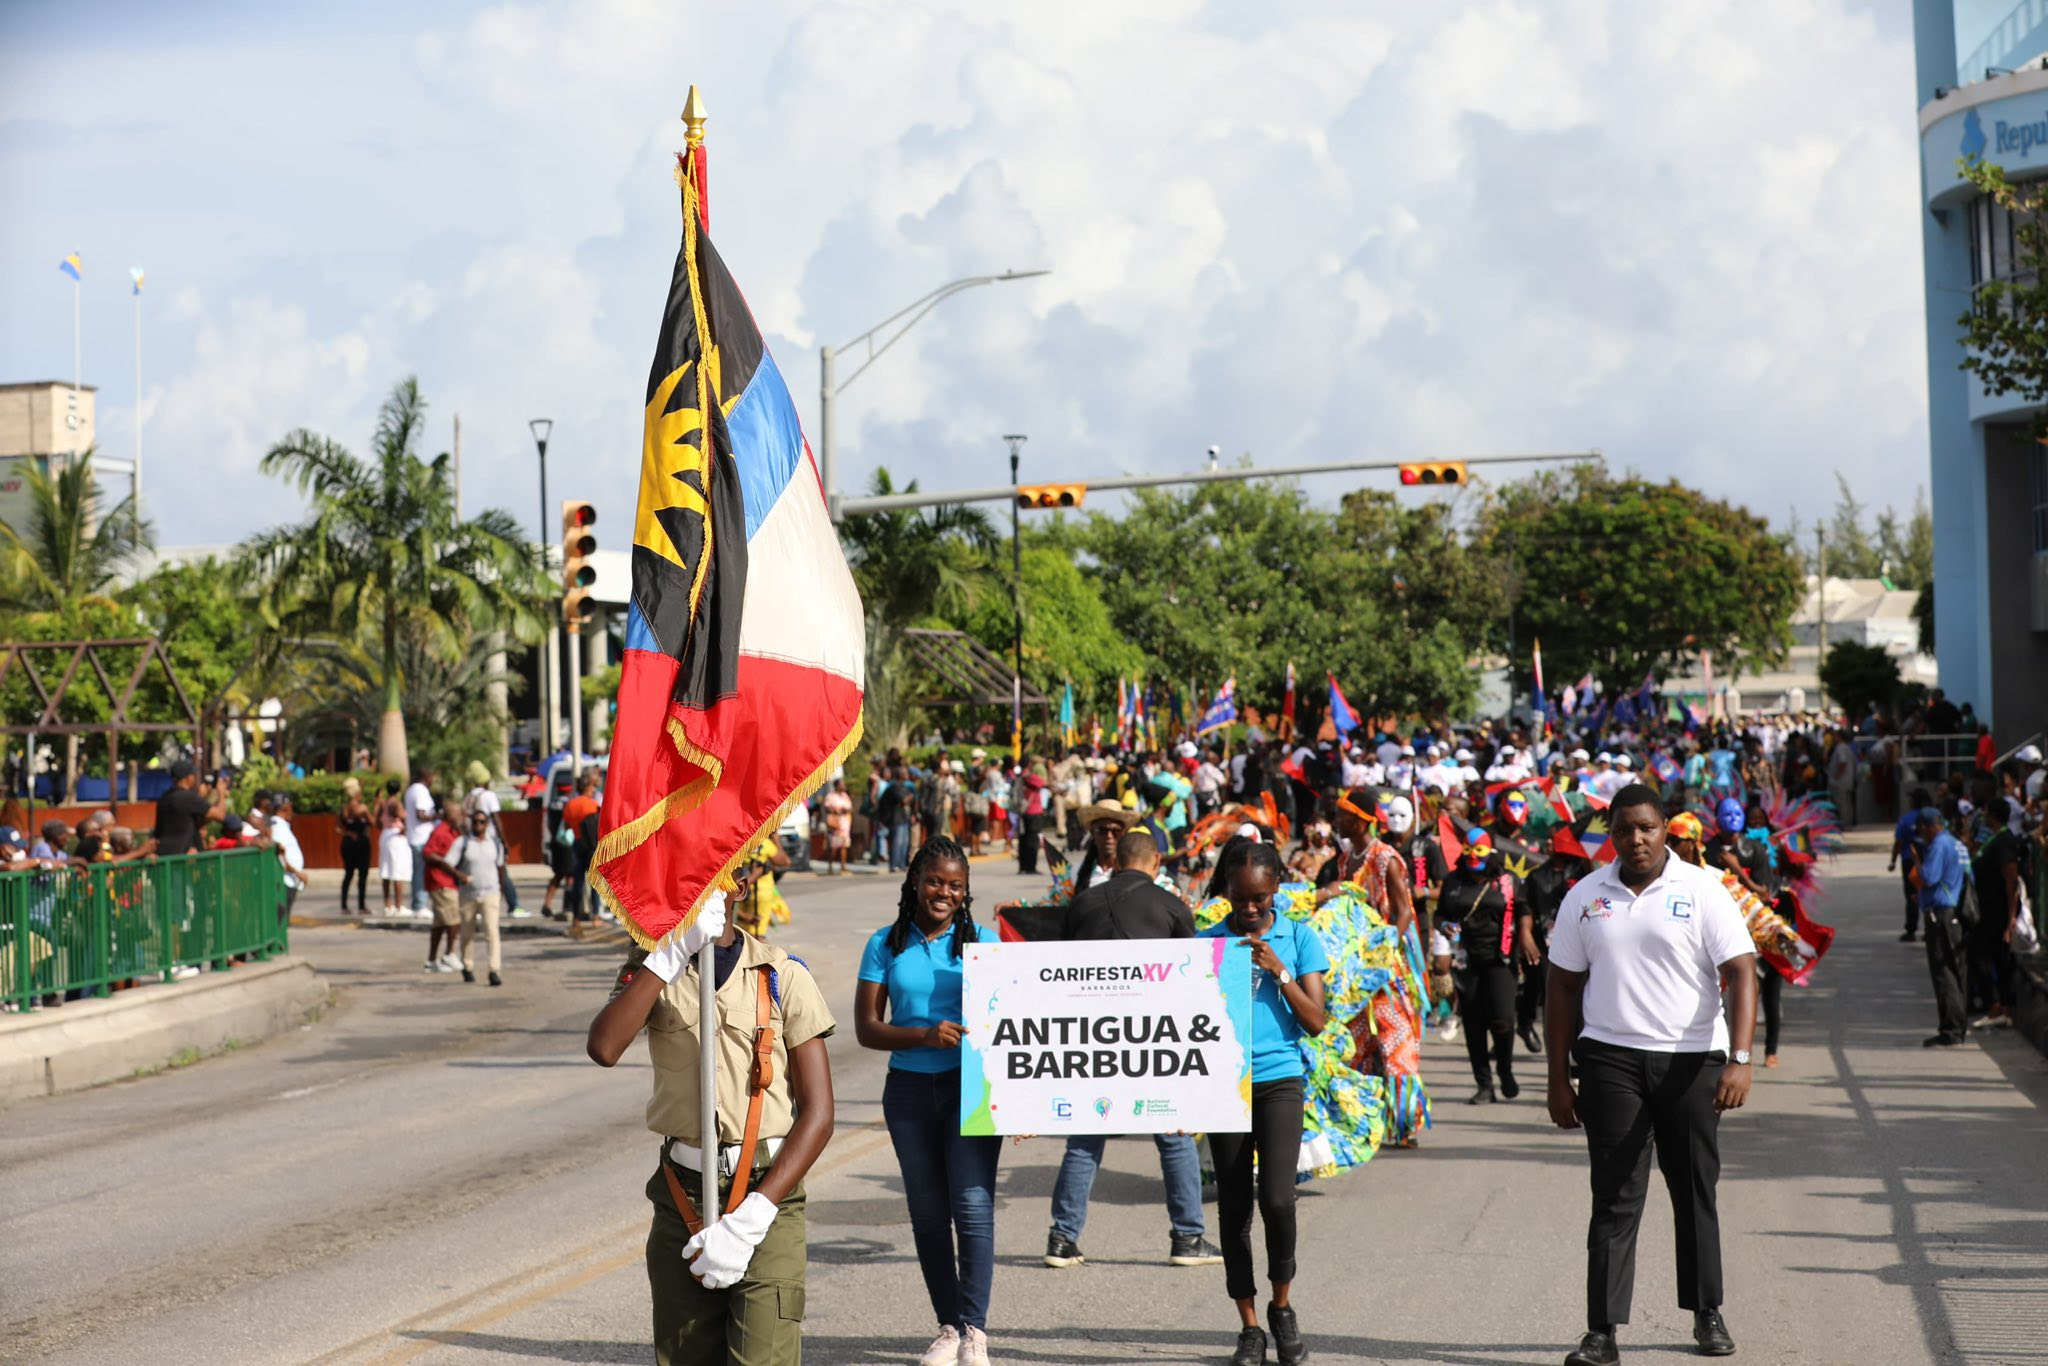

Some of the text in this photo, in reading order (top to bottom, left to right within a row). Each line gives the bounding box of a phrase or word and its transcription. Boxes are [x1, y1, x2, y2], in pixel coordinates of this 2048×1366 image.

[1995, 110, 2048, 158] Repu
[992, 1014, 1221, 1046] ANTIGUA &
[1007, 1048, 1209, 1080] BARBUDA
